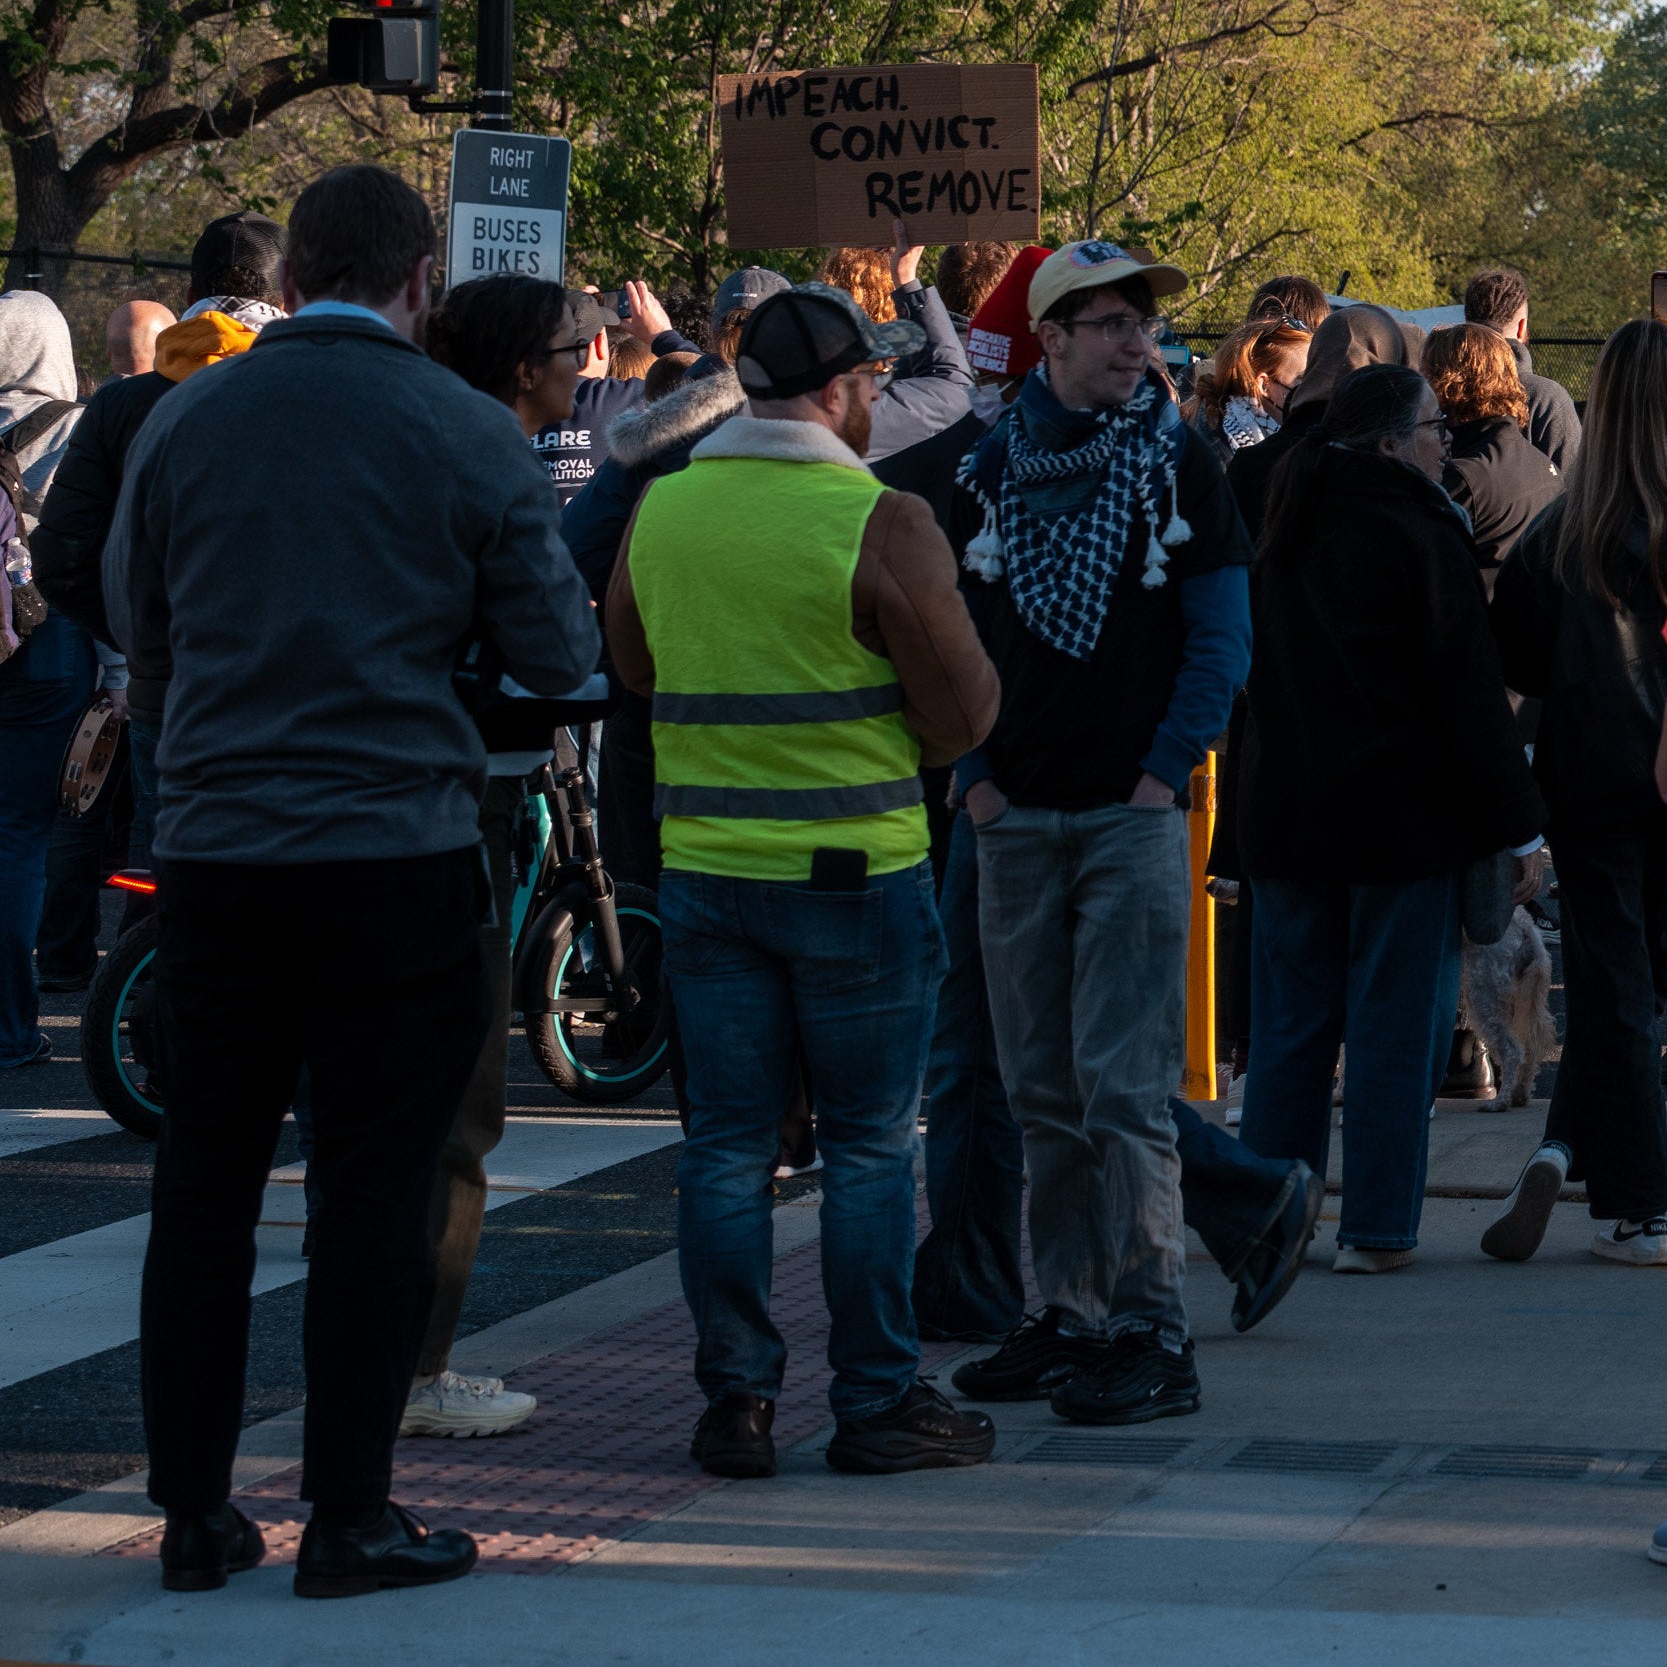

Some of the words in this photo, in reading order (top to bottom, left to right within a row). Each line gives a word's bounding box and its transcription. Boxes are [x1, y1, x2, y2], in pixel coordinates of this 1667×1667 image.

[734, 74, 909, 120] IMPEACH.
[810, 114, 999, 162] CONVICT.
[490, 147, 534, 169] RIGHT
[490, 176, 530, 198] LANE
[865, 168, 1037, 218] REMOVE.
[473, 216, 542, 245] BUSES
[472, 247, 541, 275] BIKES
[532, 429, 592, 449] LARE
[1649, 1222, 1667, 1232] NIKE
